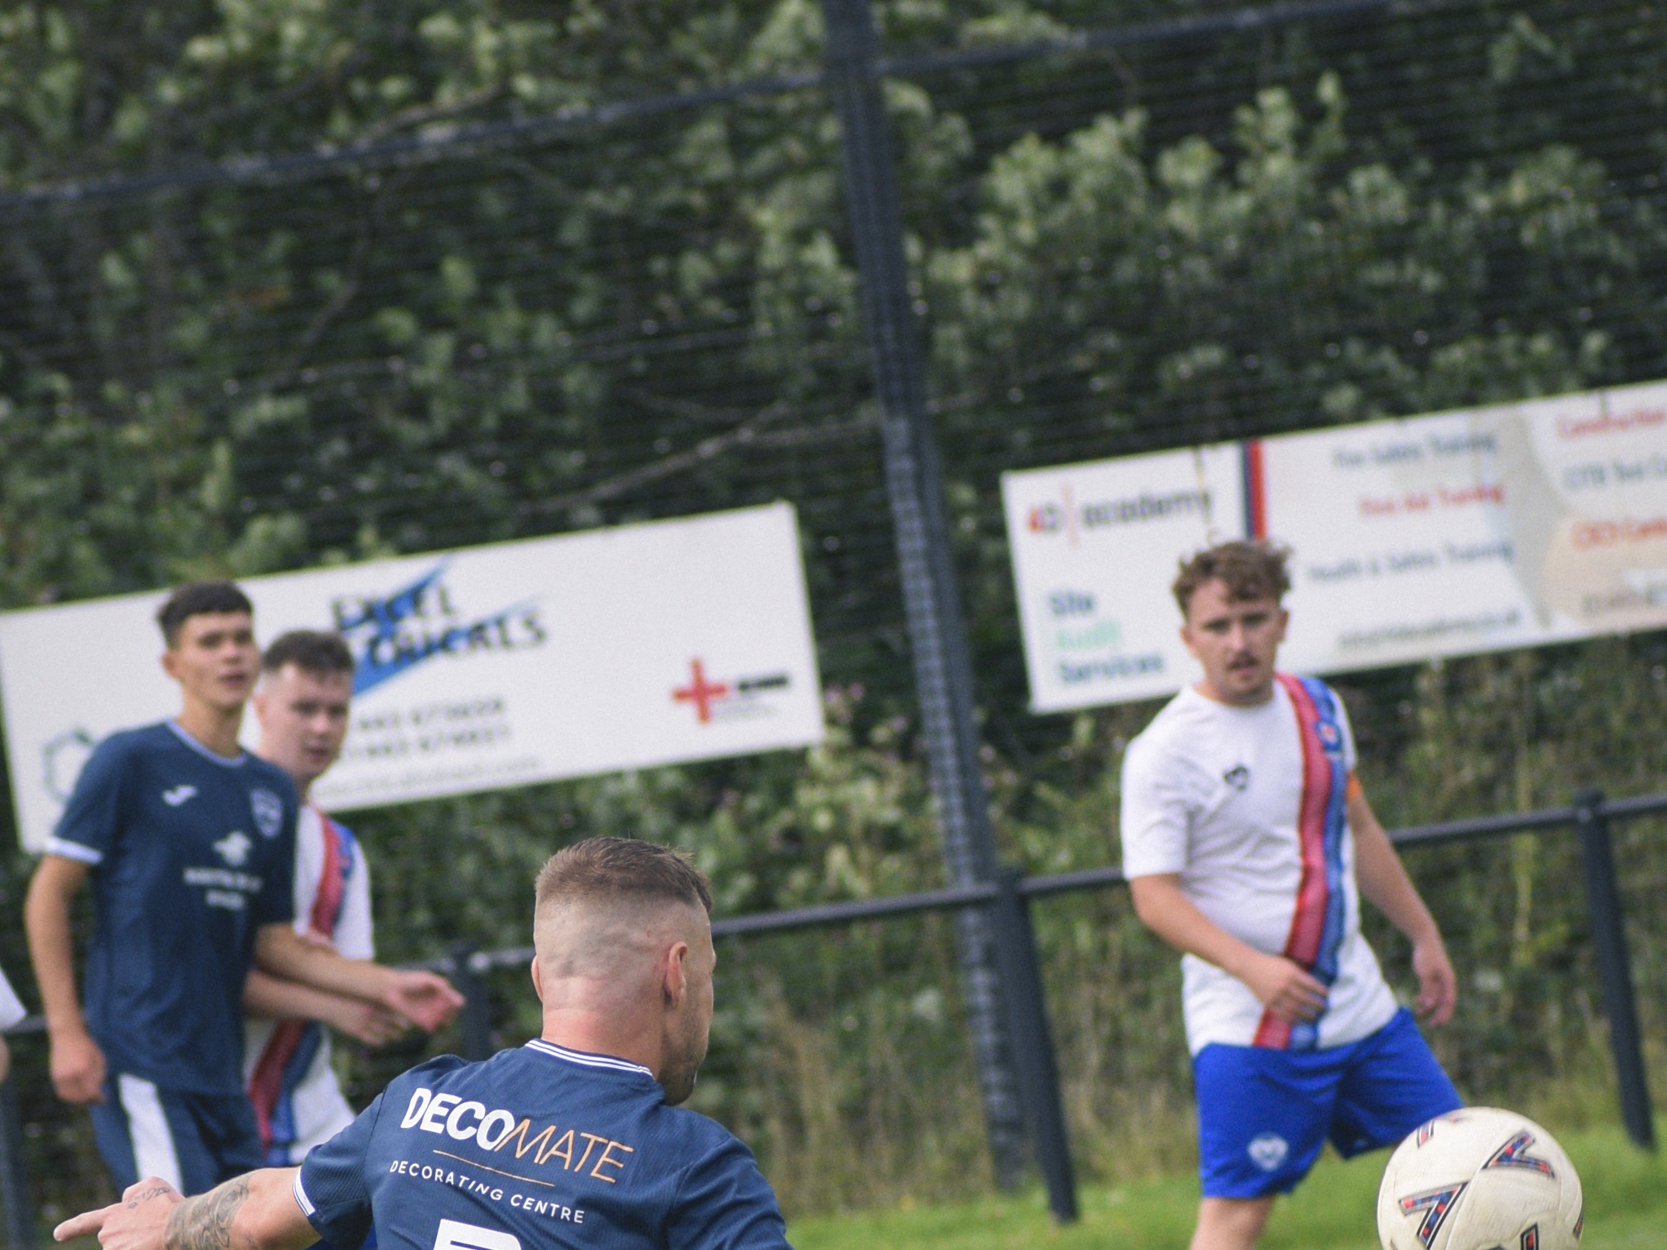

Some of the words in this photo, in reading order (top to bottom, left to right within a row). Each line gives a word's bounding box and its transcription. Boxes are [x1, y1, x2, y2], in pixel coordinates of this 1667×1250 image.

[1082, 491, 1210, 529] academy
[366, 610, 547, 667] TRICALS
[389, 1159, 504, 1201] DECORATING
[510, 1193, 586, 1224] CENTRE
